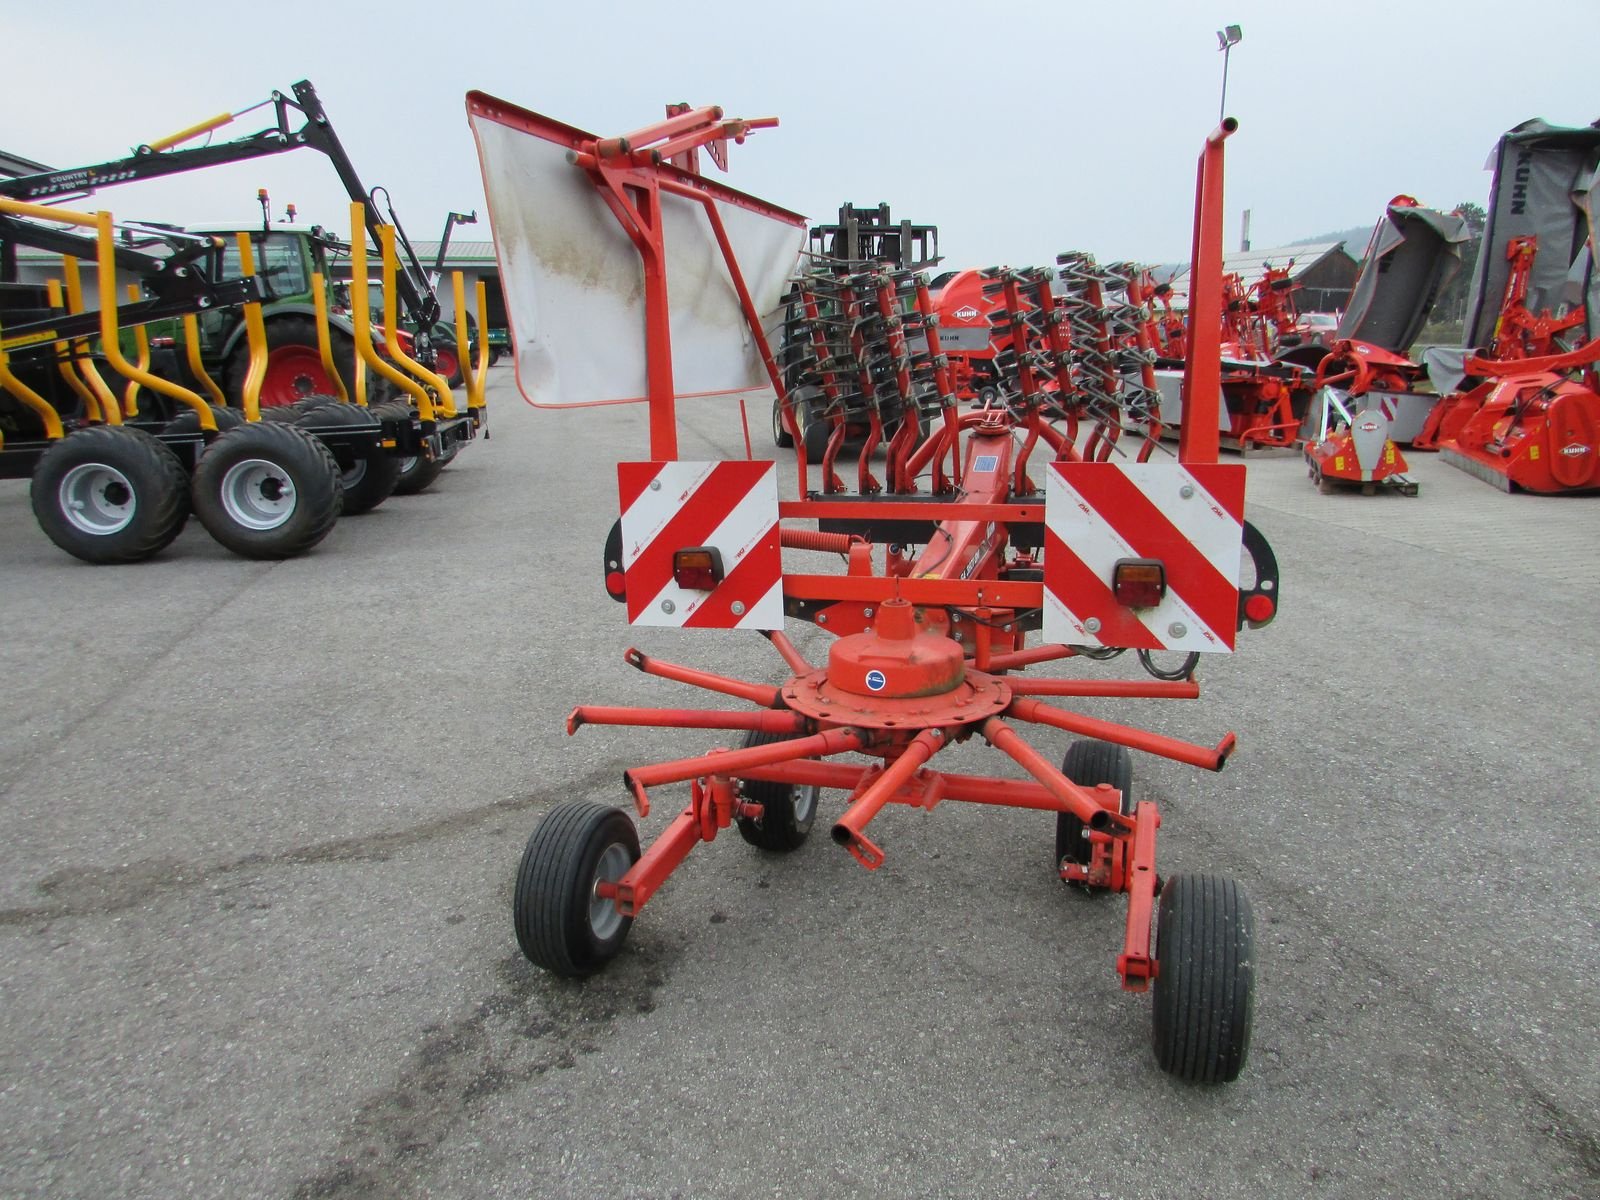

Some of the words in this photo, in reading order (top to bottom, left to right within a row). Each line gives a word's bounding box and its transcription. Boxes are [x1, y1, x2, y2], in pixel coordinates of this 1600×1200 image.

[50, 171, 88, 183] COUNTRY
[1510, 152, 1532, 215] KUHN
[956, 310, 977, 318] KUHN
